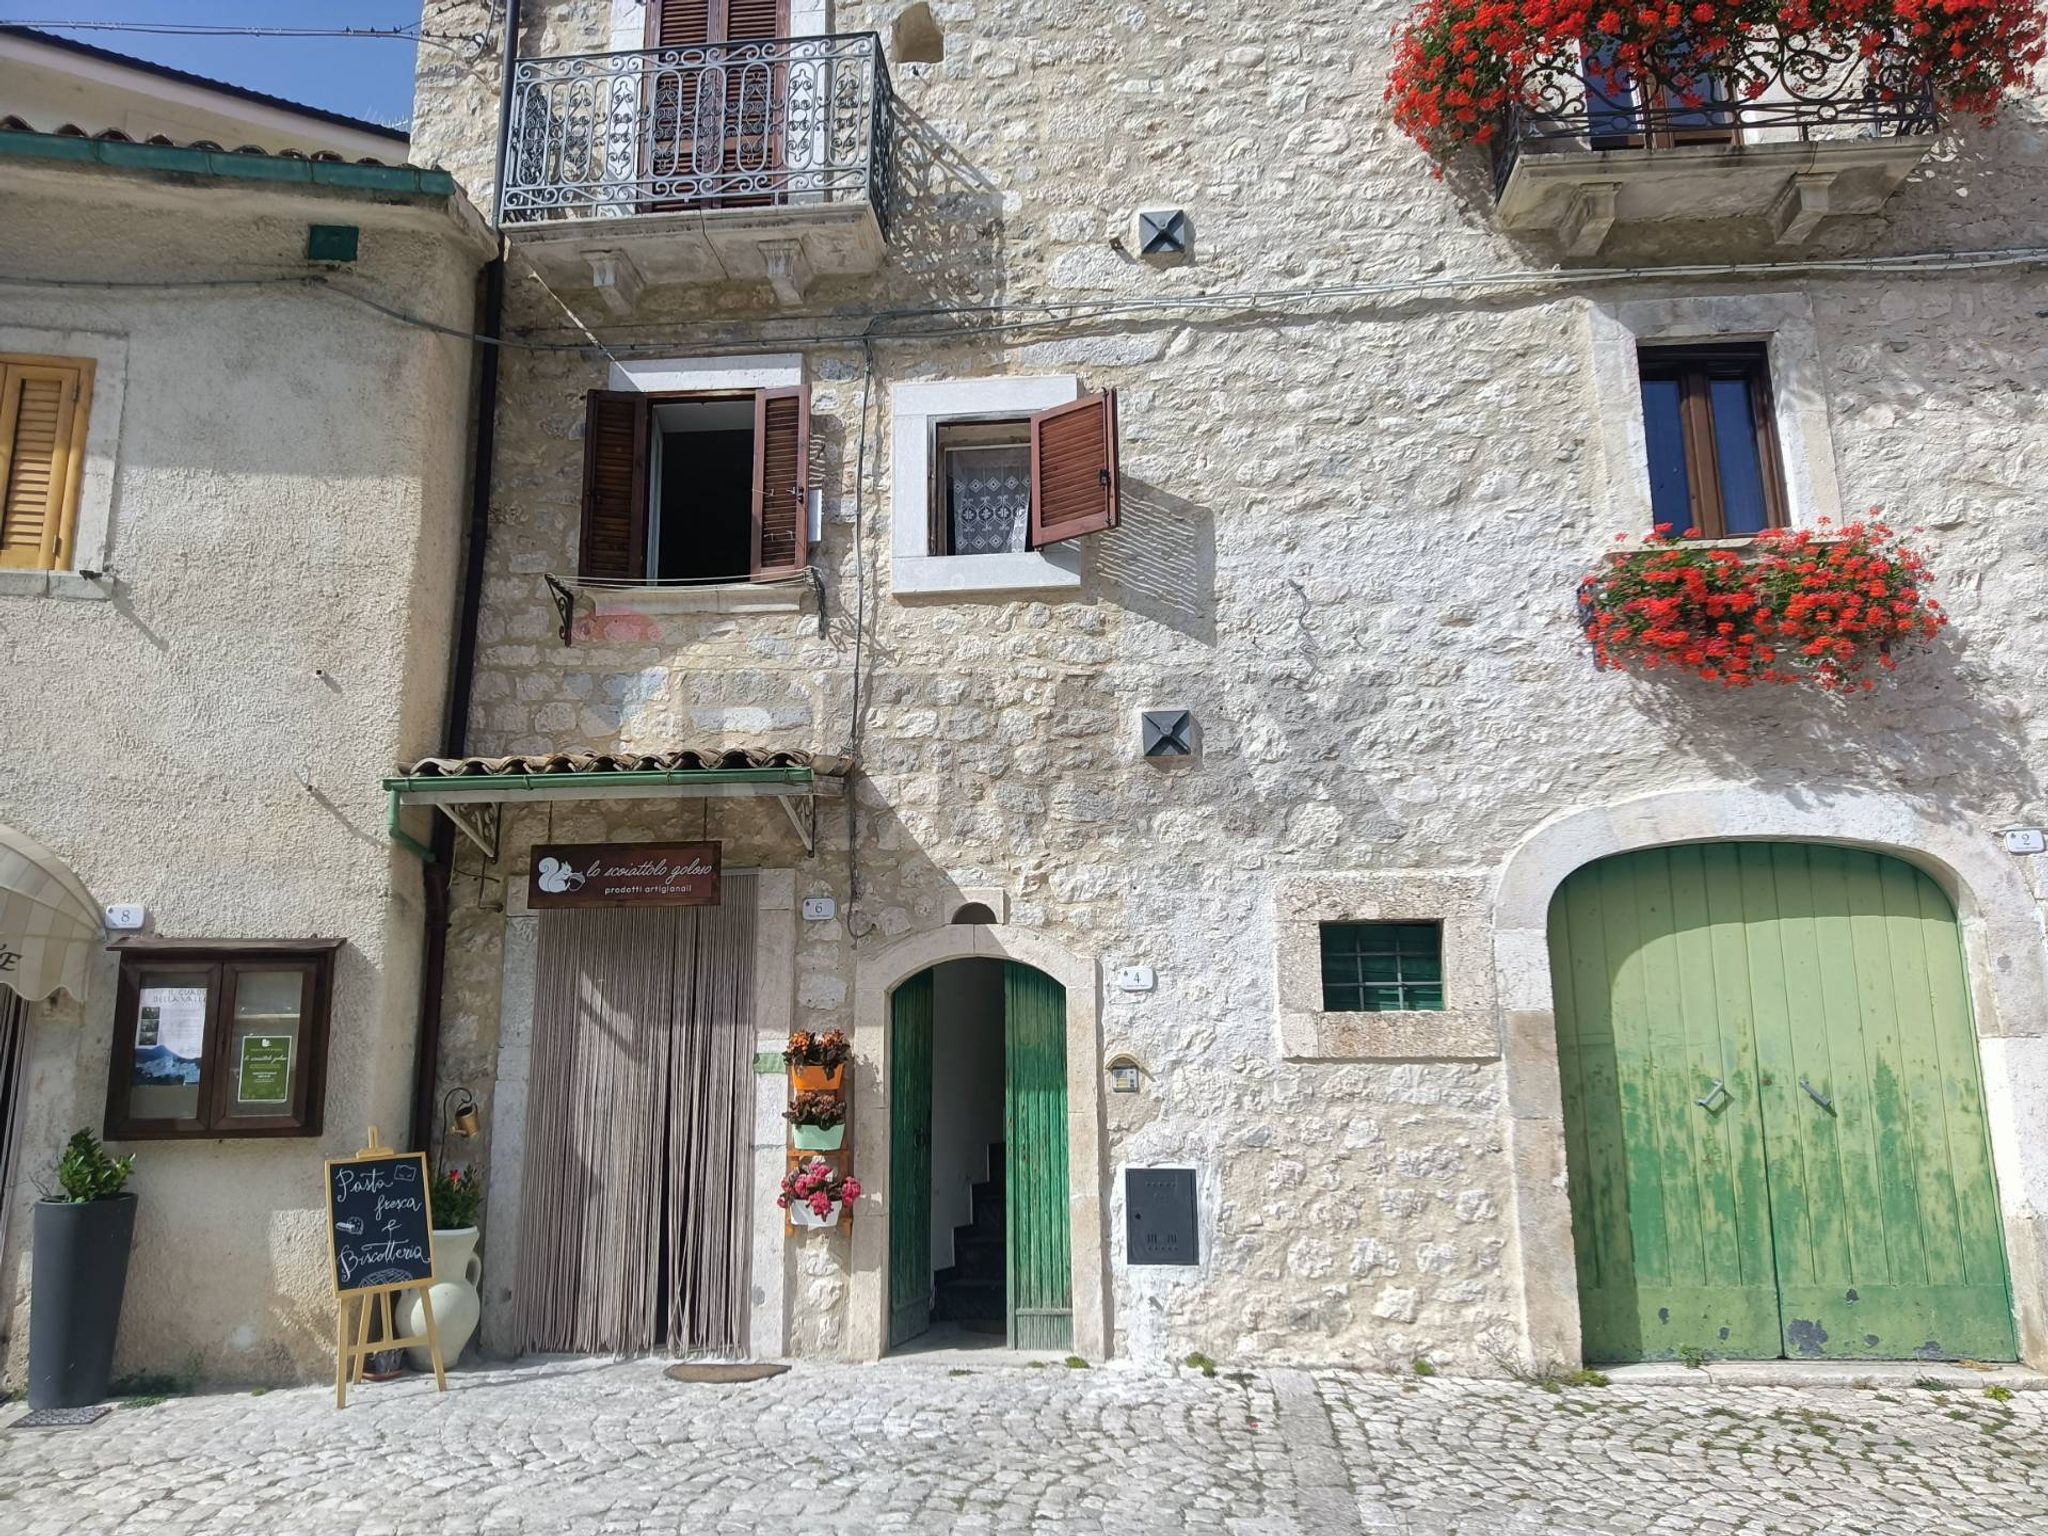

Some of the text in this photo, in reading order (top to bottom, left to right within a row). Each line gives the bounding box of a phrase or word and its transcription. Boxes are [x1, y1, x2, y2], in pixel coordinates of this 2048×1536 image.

[2021, 833, 2030, 845] 2
[586, 857, 713, 885] lo scoiattolo goloso
[604, 886, 642, 895] prodotti
[815, 902, 823, 913] 6
[121, 909, 131, 923] 8
[1133, 971, 1141, 984] 4
[335, 1167, 393, 1202] Pasta
[374, 1194, 422, 1221] fresca
[337, 1239, 431, 1282] Biscotteria
